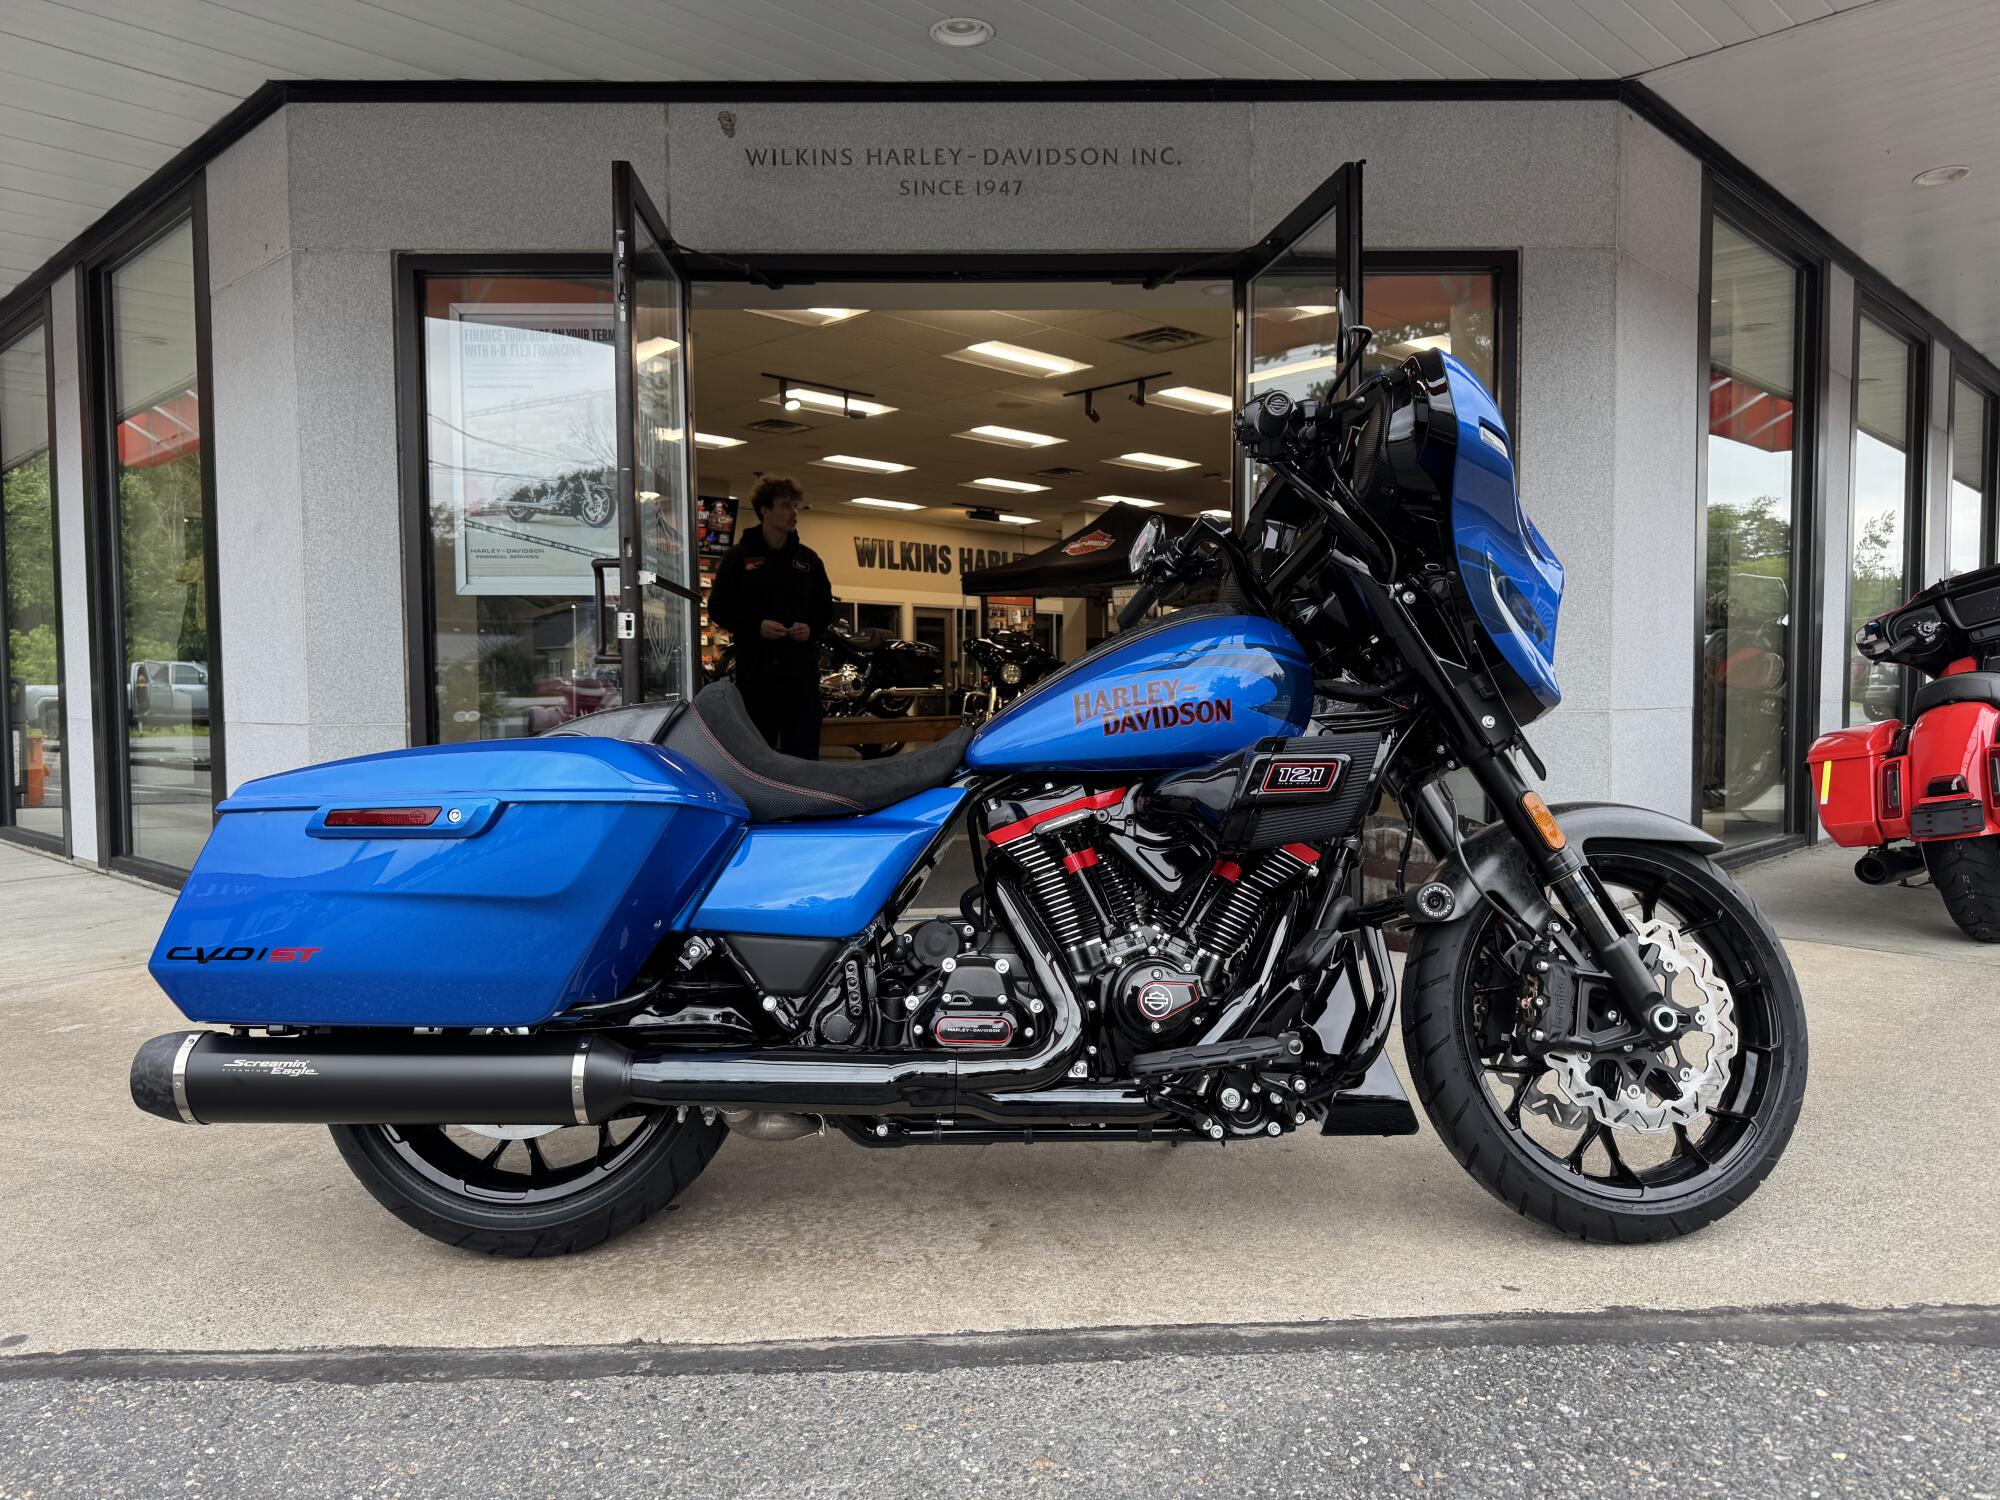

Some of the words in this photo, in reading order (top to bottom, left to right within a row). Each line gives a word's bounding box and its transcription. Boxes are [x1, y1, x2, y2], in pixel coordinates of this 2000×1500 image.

[745, 148, 853, 167] WILKINS
[866, 147, 1119, 167] HARLEY-DAVIDSON
[1132, 147, 1182, 166] INC.
[900, 180, 965, 196] SINCE
[976, 180, 1023, 196] 1947
[591, 328, 615, 343] TERM
[853, 536, 952, 575] WILKINS
[1102, 697, 1233, 737] DAVIDSON
[1278, 767, 1325, 782] 121
[270, 1066, 319, 1077] Eagle
